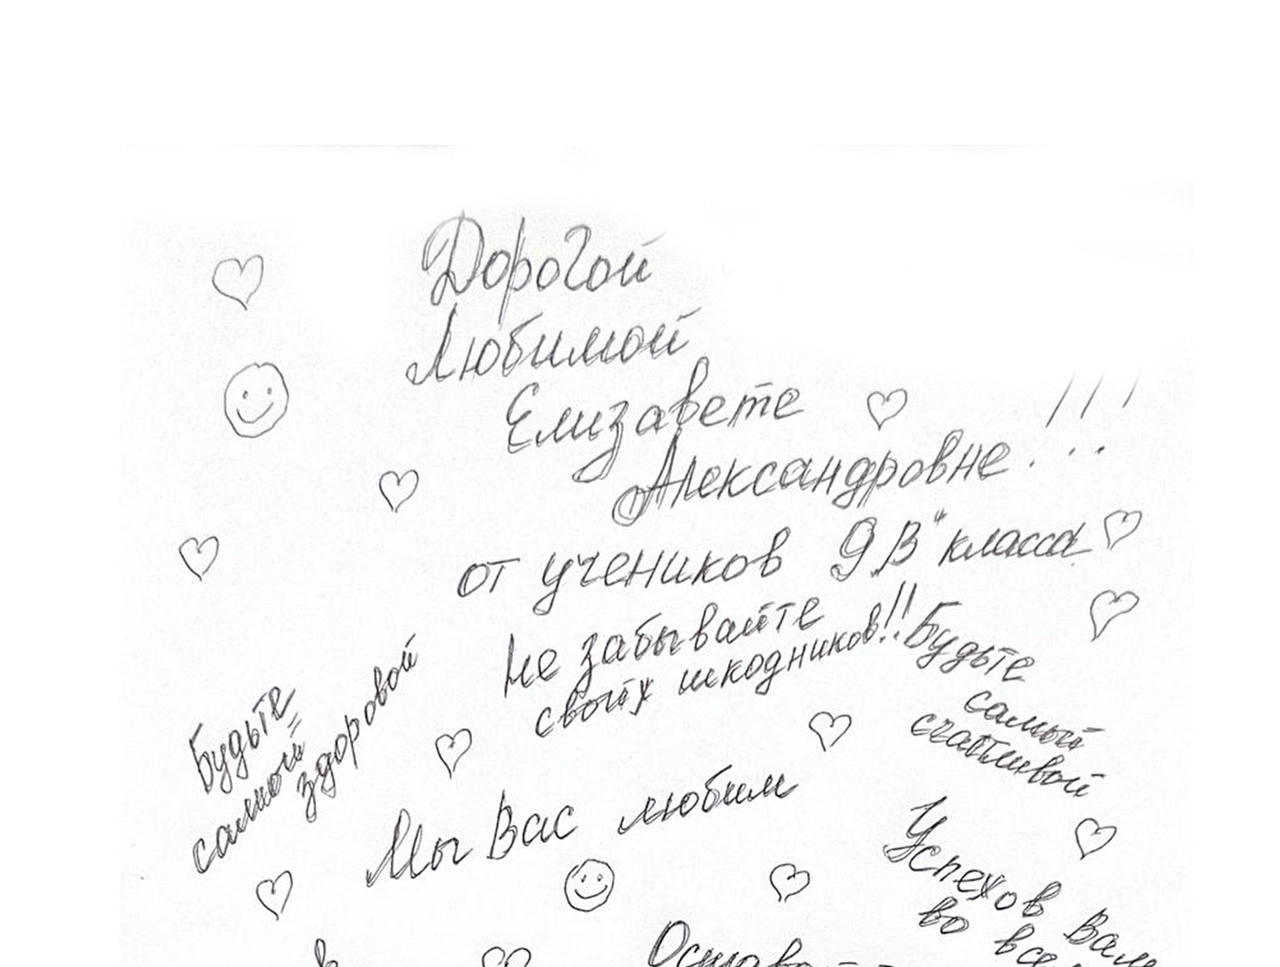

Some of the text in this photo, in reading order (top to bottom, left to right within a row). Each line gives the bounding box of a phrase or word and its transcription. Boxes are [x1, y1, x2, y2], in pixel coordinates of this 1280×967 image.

[421, 209, 667, 329] Дорогой
[406, 302, 702, 387] Любимой
[506, 356, 805, 483] Елизавете
[457, 557, 521, 598] от
[532, 527, 791, 615] учеников
[504, 596, 825, 699] Не забывайте
[903, 601, 1036, 683] Будьте
[188, 686, 296, 795] Будьте
[296, 633, 418, 823] здоровой
[365, 808, 474, 888] Мы
[616, 764, 799, 835] любим
[882, 795, 1063, 918] Успехов
[918, 896, 971, 935] во
